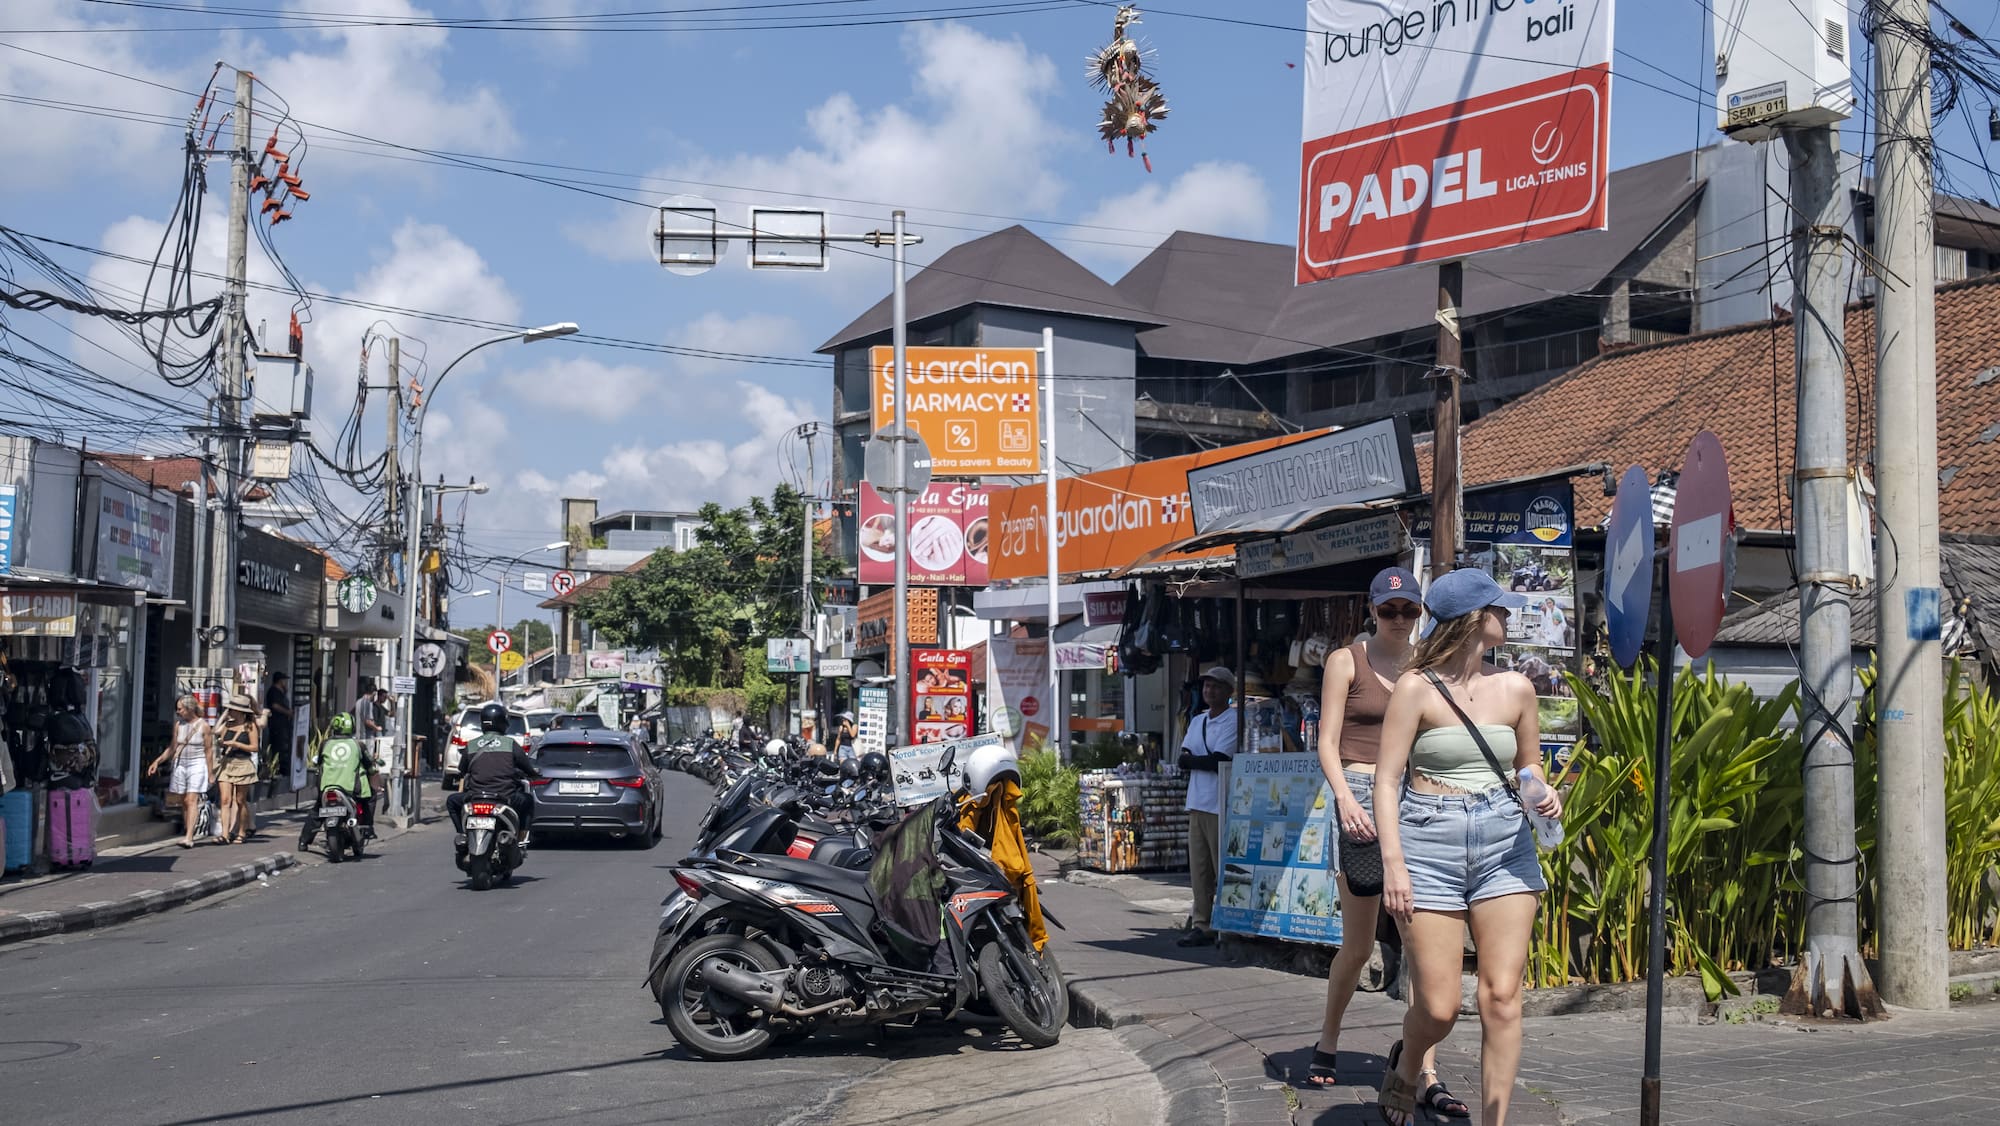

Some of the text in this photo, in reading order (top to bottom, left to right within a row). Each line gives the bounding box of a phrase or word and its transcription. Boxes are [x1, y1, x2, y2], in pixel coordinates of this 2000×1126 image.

[1527, 5, 1573, 42] bali
[1324, 11, 1425, 66] lounge
[1732, 106, 1756, 120] SEM
[1766, 98, 1785, 112] 011
[1506, 162, 1587, 192] LIGA.TENNIS
[1319, 148, 1497, 233] PADEL
[931, 457, 991, 467] Extra savers
[997, 456, 1032, 468] Beauty
[1199, 464, 1266, 523] TOURIST
[1264, 433, 1395, 508] INFORMATION
[947, 487, 989, 510] Spa
[1533, 501, 1559, 513] MASON
[1056, 493, 1151, 548] guardian
[1463, 511, 1521, 522] OLIDAYS INTO
[1526, 512, 1567, 532] ADVENTURES
[1316, 519, 1389, 541] RENTAL MOTOR
[1469, 524, 1519, 535] SINCE 1989
[1330, 530, 1390, 551] RENTAL CAR
[240, 560, 289, 595] STARBUCKS
[949, 574, 965, 582] Hair
[1389, 576, 1402, 590] B
[2, 596, 71, 617] SIM CARD
[1090, 601, 1108, 617] SIM
[822, 663, 849, 672] papiya
[919, 652, 966, 664] Carla Spa
[1245, 760, 1262, 773] DIVE
[1264, 760, 1280, 773] AND
[1281, 760, 1308, 773] WATER
